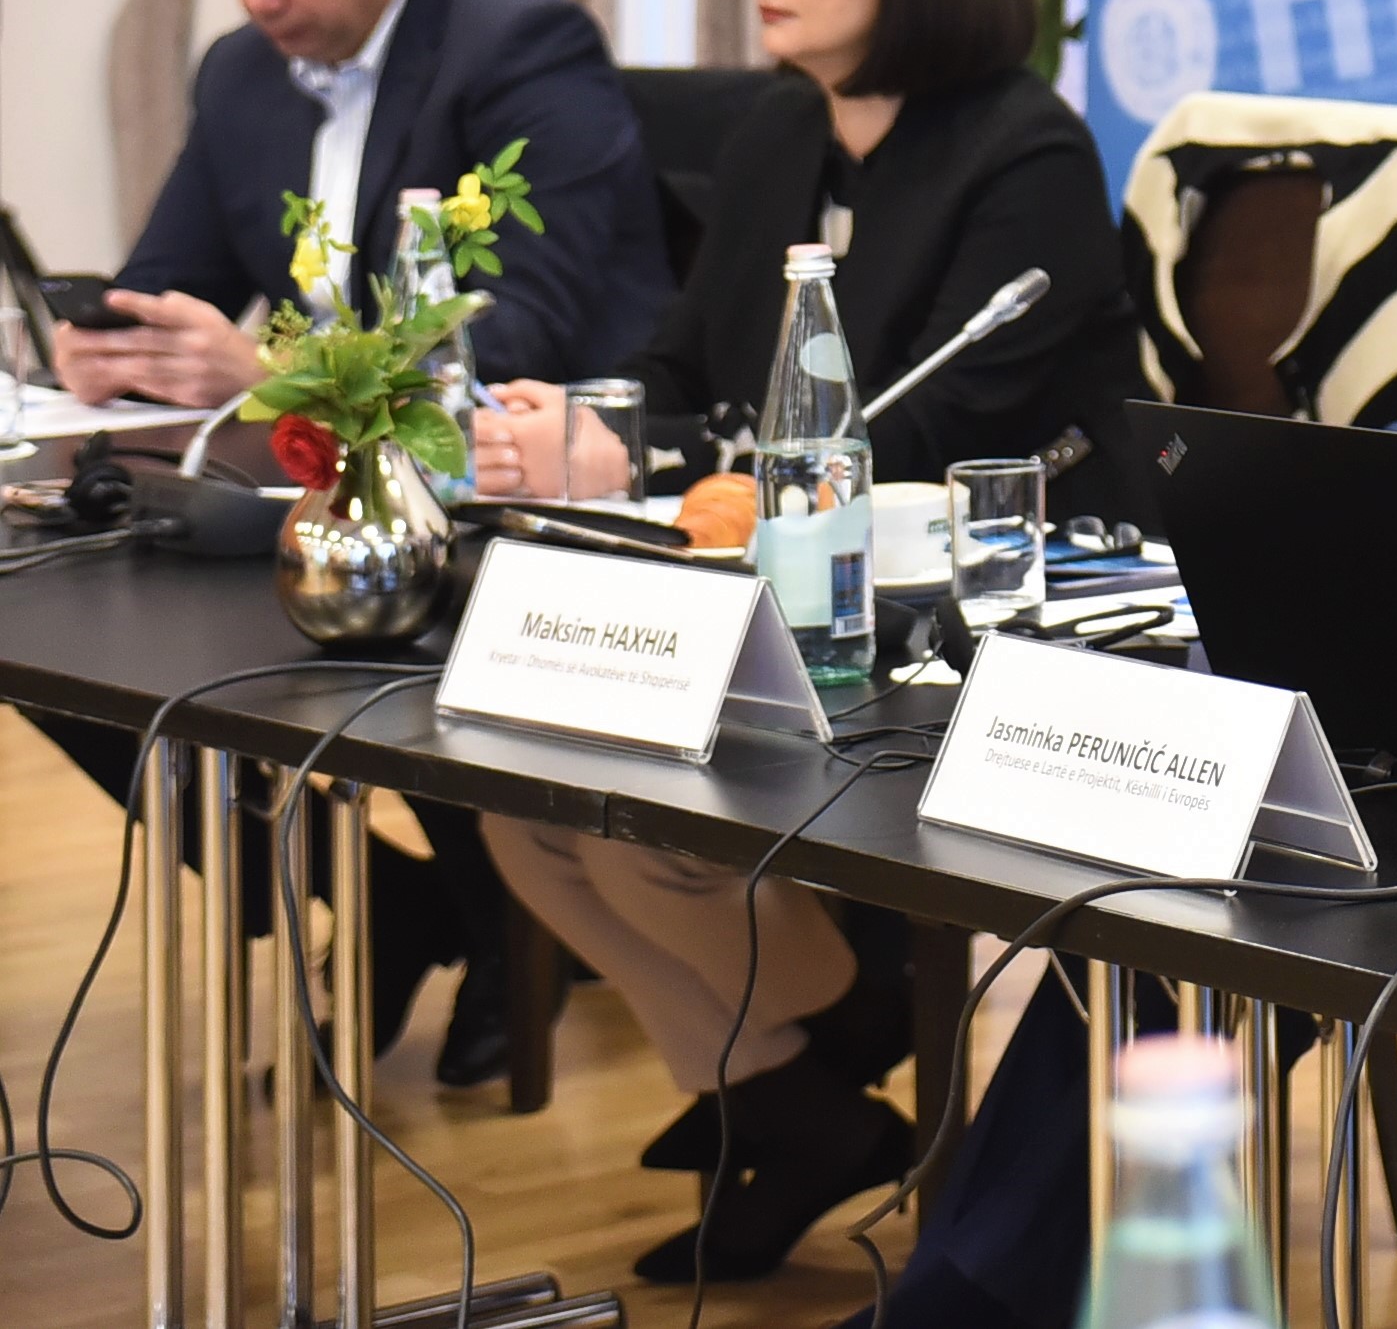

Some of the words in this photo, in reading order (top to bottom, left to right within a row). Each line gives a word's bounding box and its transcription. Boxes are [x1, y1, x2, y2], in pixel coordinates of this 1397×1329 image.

[520, 611, 597, 647] Maksim
[599, 622, 679, 660] HAXHIA
[984, 748, 1031, 769] Drejtuese
[1032, 761, 1040, 773] e
[1041, 760, 1068, 779] Lartë
[1068, 769, 1076, 781] e
[1124, 779, 1162, 800] Këshilli
[1168, 788, 1211, 811] Evropës
[986, 715, 1064, 752] Jasminka
[1067, 732, 1168, 773] PERUNIČIĆ
[1164, 753, 1226, 787] ALLEN
